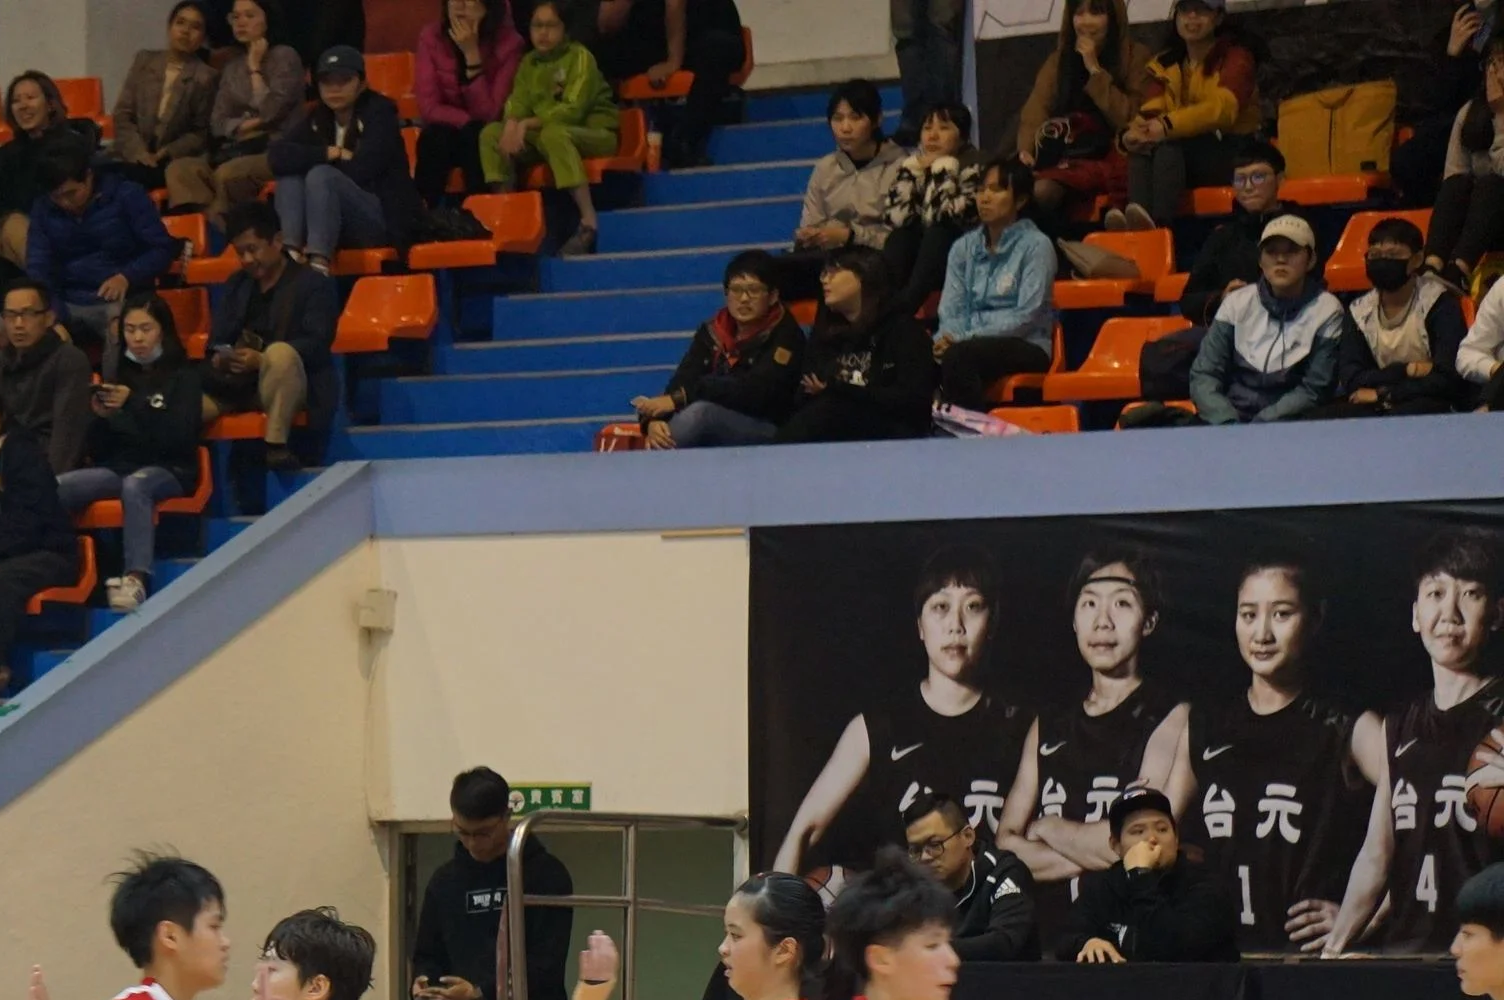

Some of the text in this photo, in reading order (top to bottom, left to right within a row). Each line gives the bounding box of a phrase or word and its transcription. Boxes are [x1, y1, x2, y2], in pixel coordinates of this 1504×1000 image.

[1202, 782, 1303, 844] 台元
[1392, 774, 1477, 833] 台元
[1237, 864, 1255, 925] 1
[1415, 853, 1439, 912] 4
